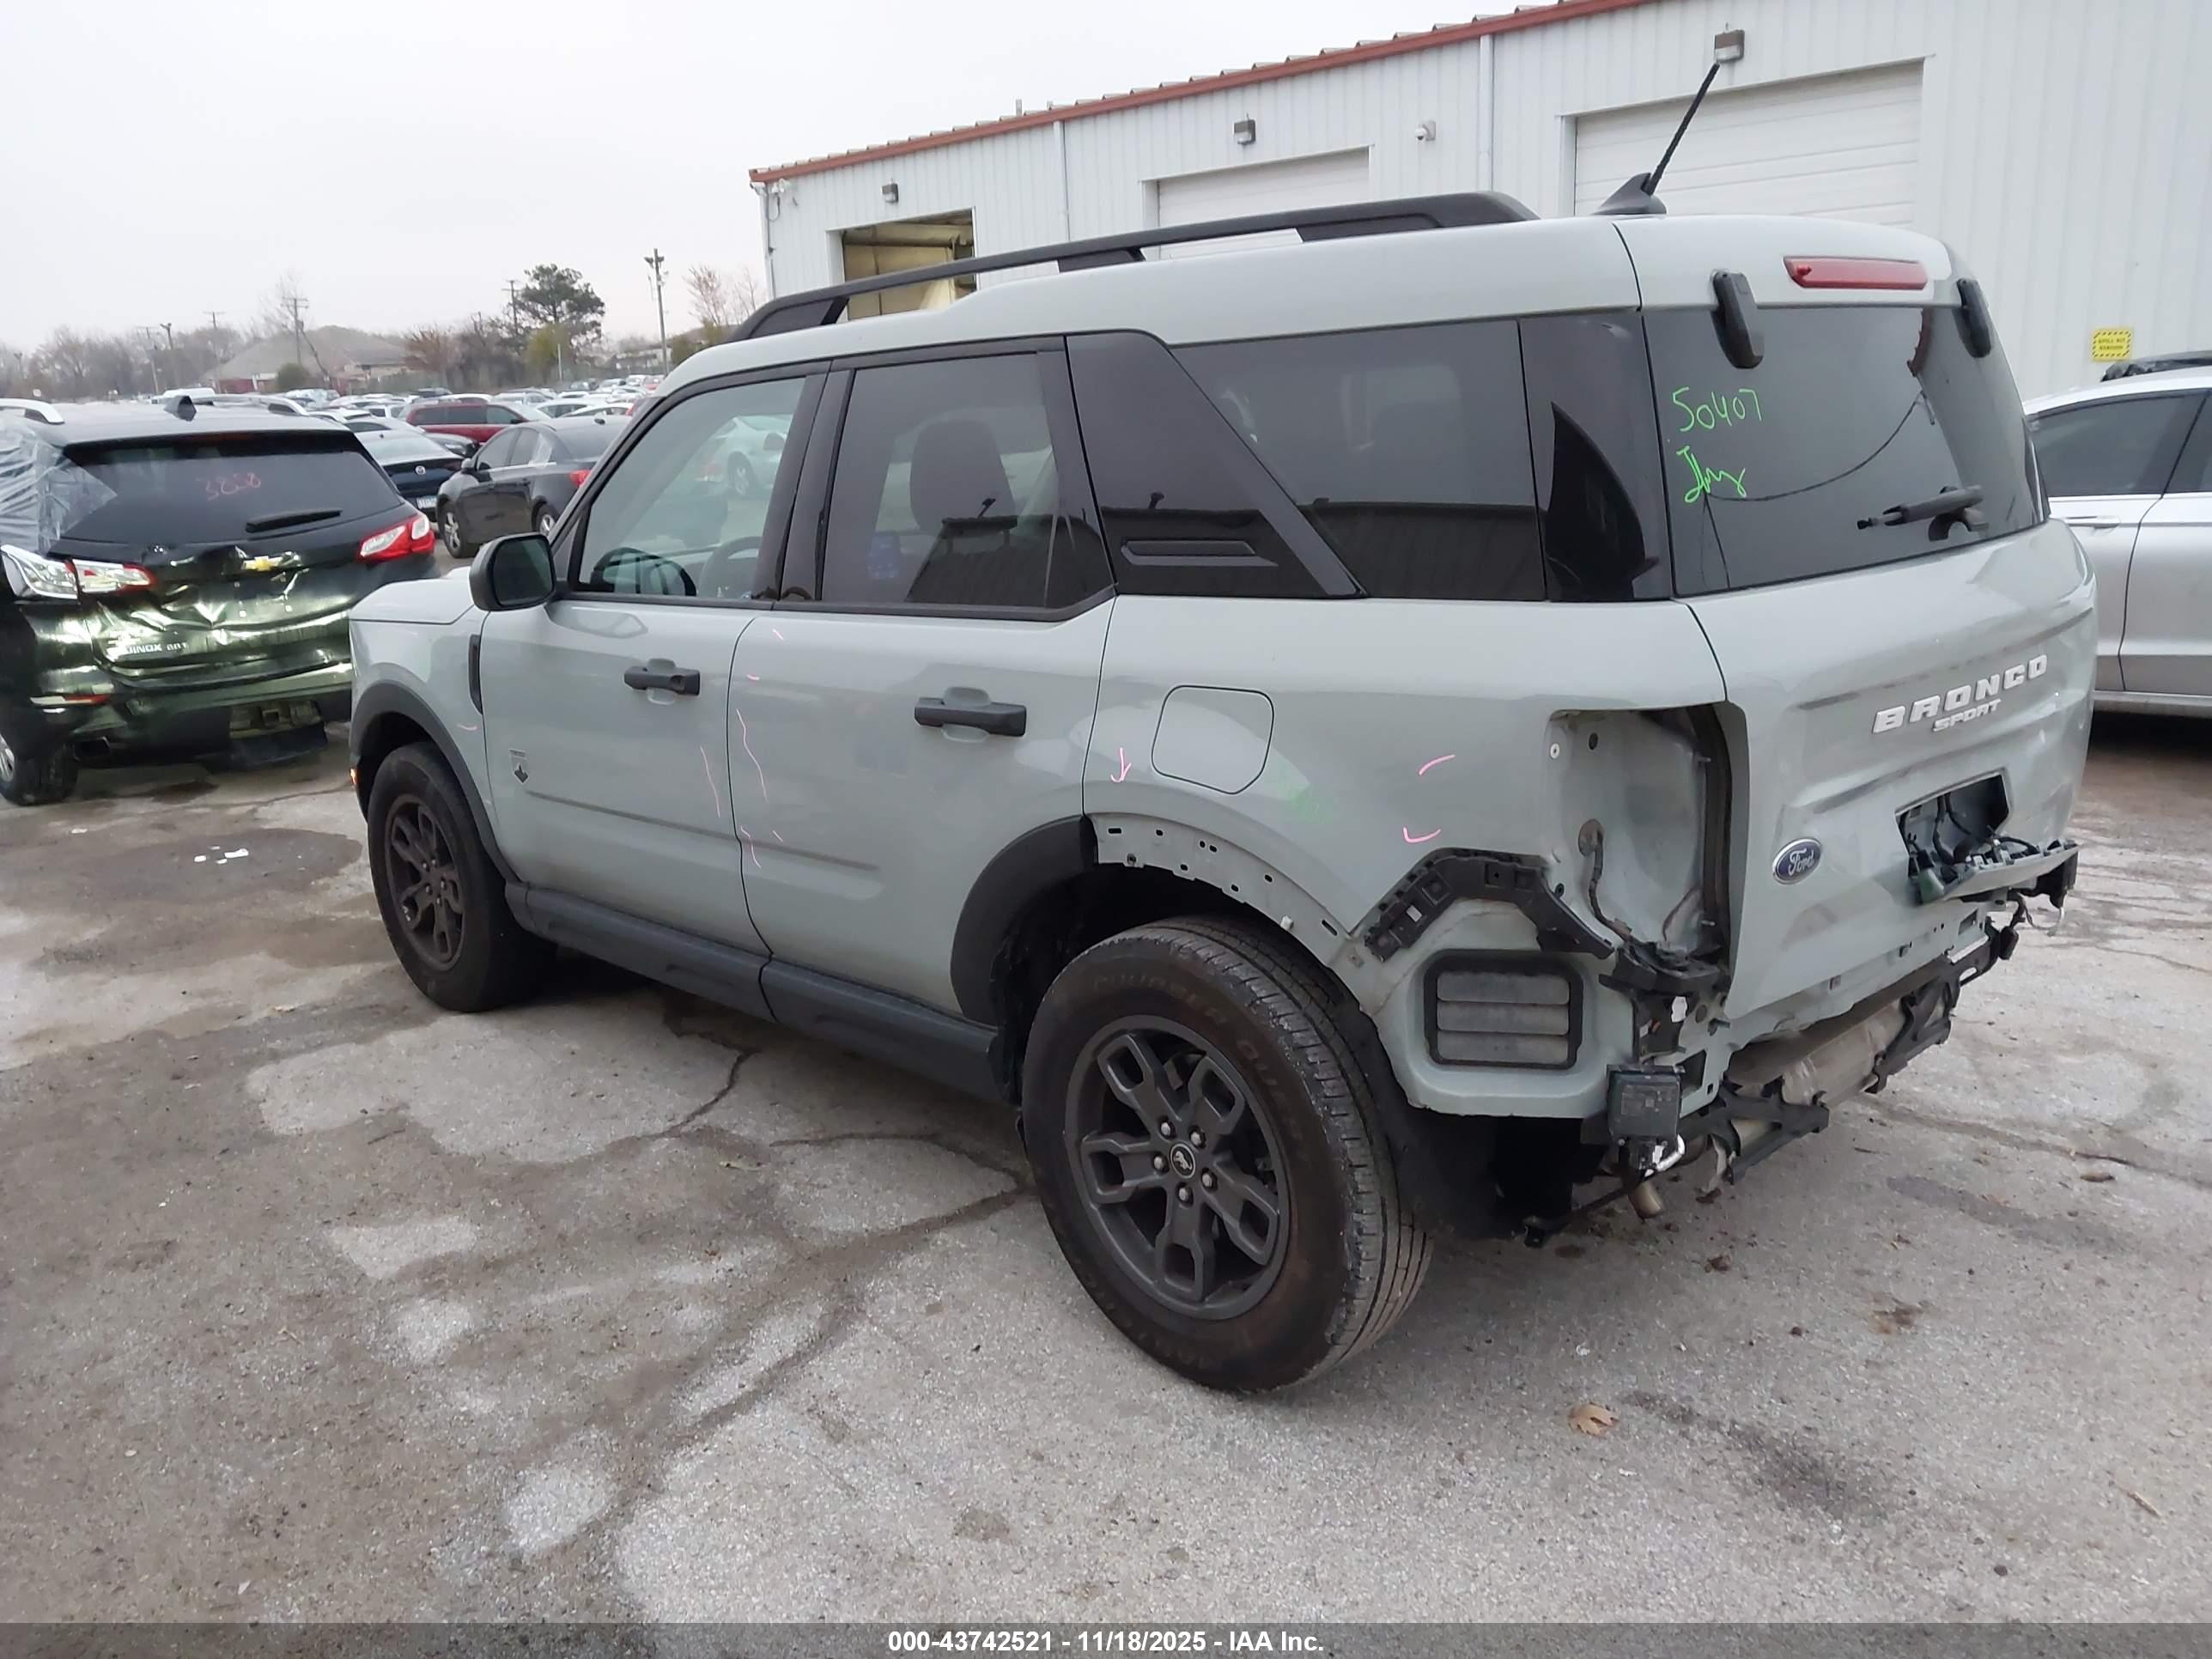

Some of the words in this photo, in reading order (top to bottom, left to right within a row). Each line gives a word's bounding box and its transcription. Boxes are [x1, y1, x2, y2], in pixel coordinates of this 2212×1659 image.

[1672, 386, 1763, 433] 50407
[1872, 653, 2049, 734] BRONCO
[1931, 698, 2002, 733] SPORT
[1788, 847, 1815, 877] Ford
